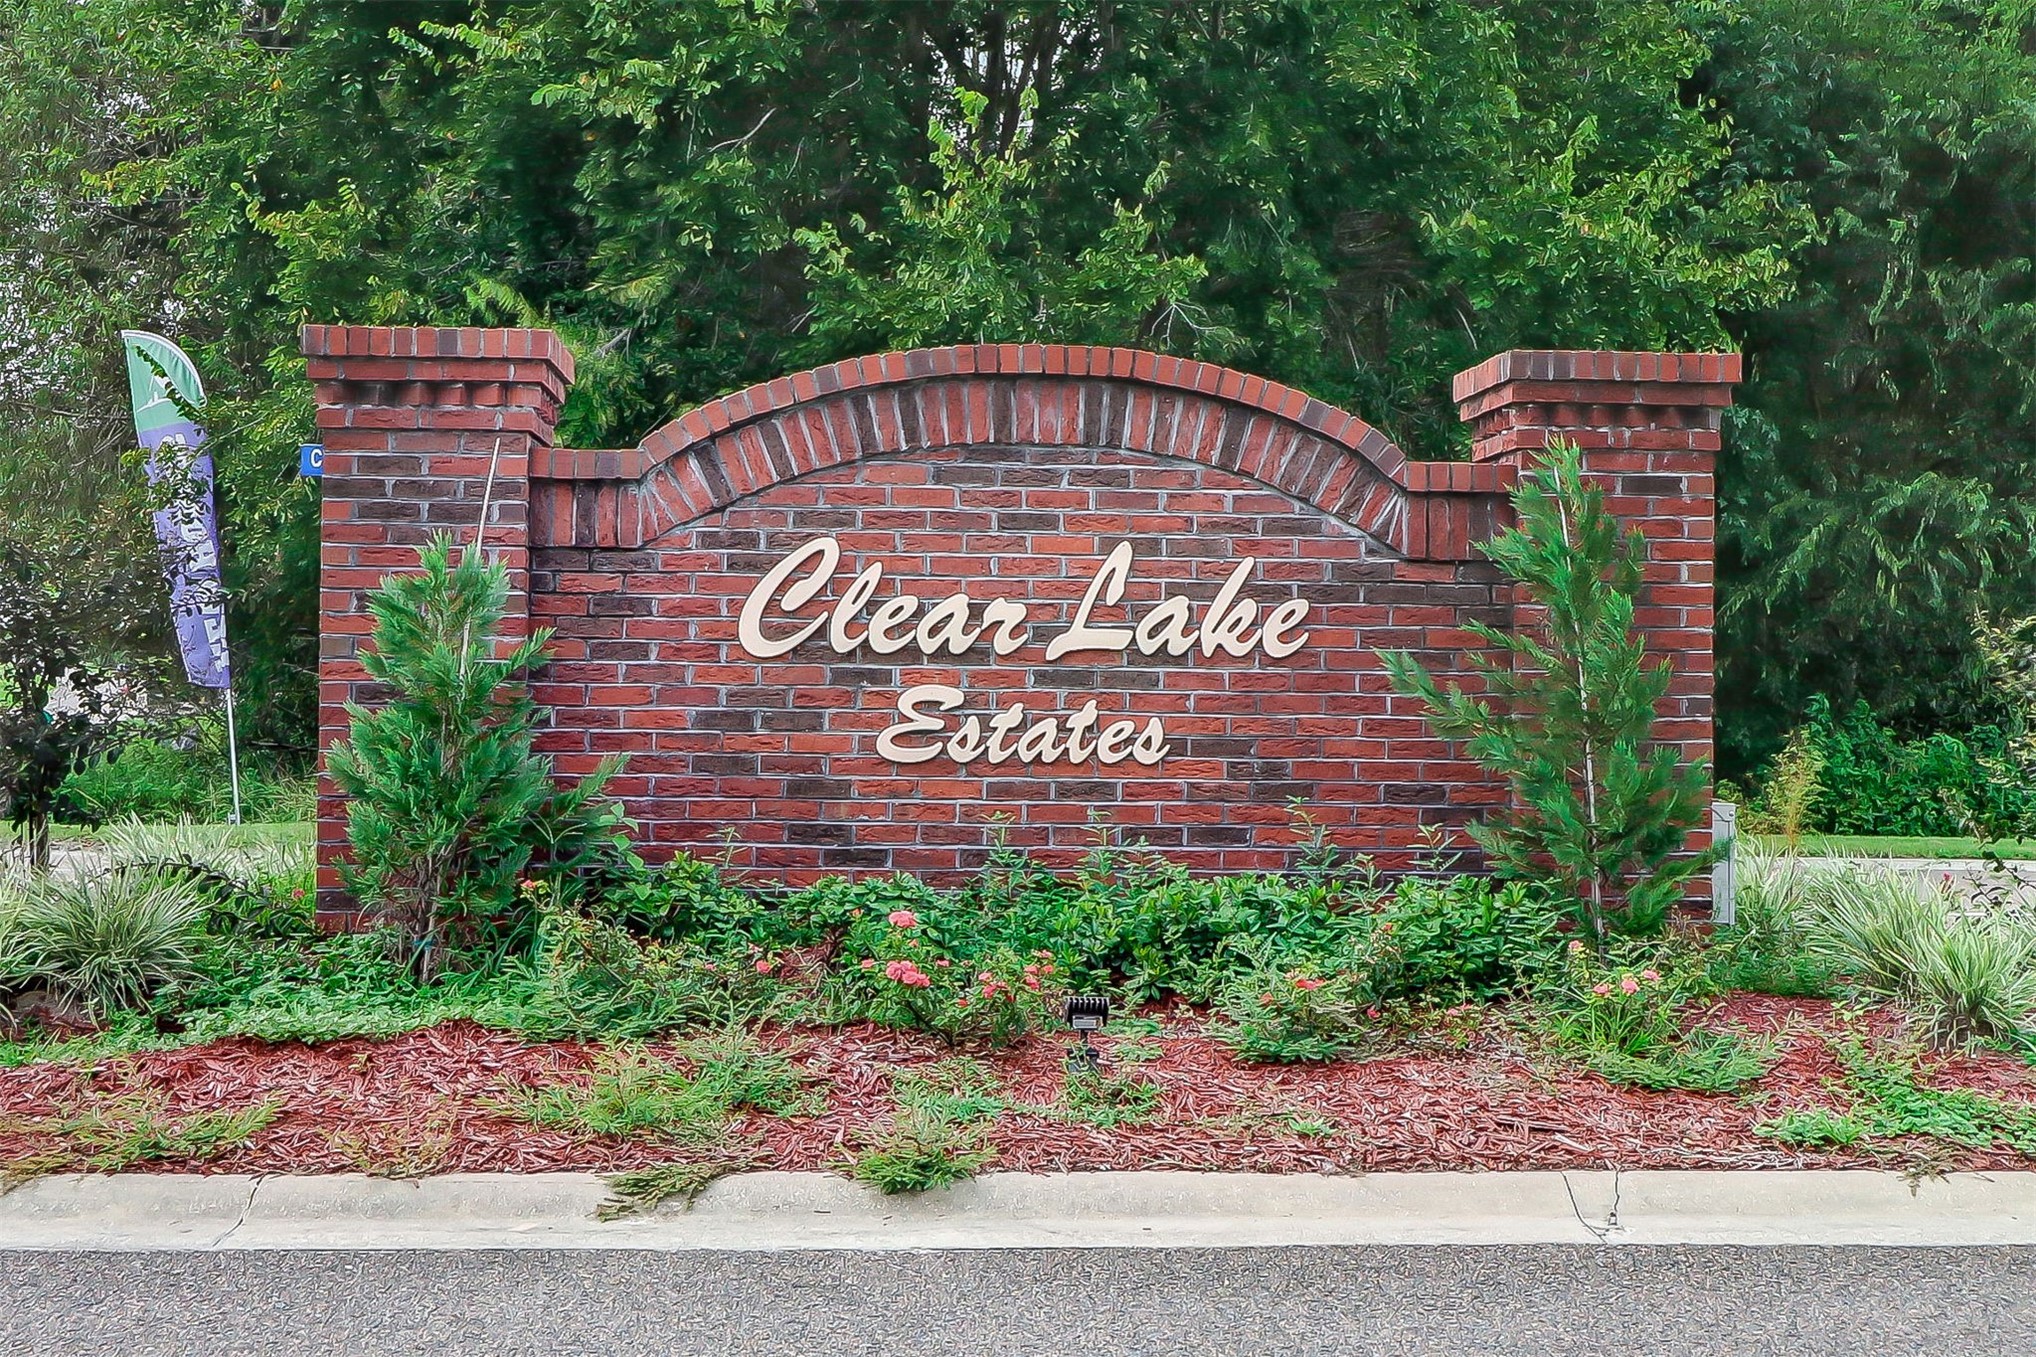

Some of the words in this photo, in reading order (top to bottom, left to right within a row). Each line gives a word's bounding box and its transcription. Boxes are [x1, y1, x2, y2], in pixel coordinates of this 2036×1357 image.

[738, 536, 1029, 659] Clear
[1045, 540, 1310, 661] Lake
[876, 685, 1170, 765] Estates
